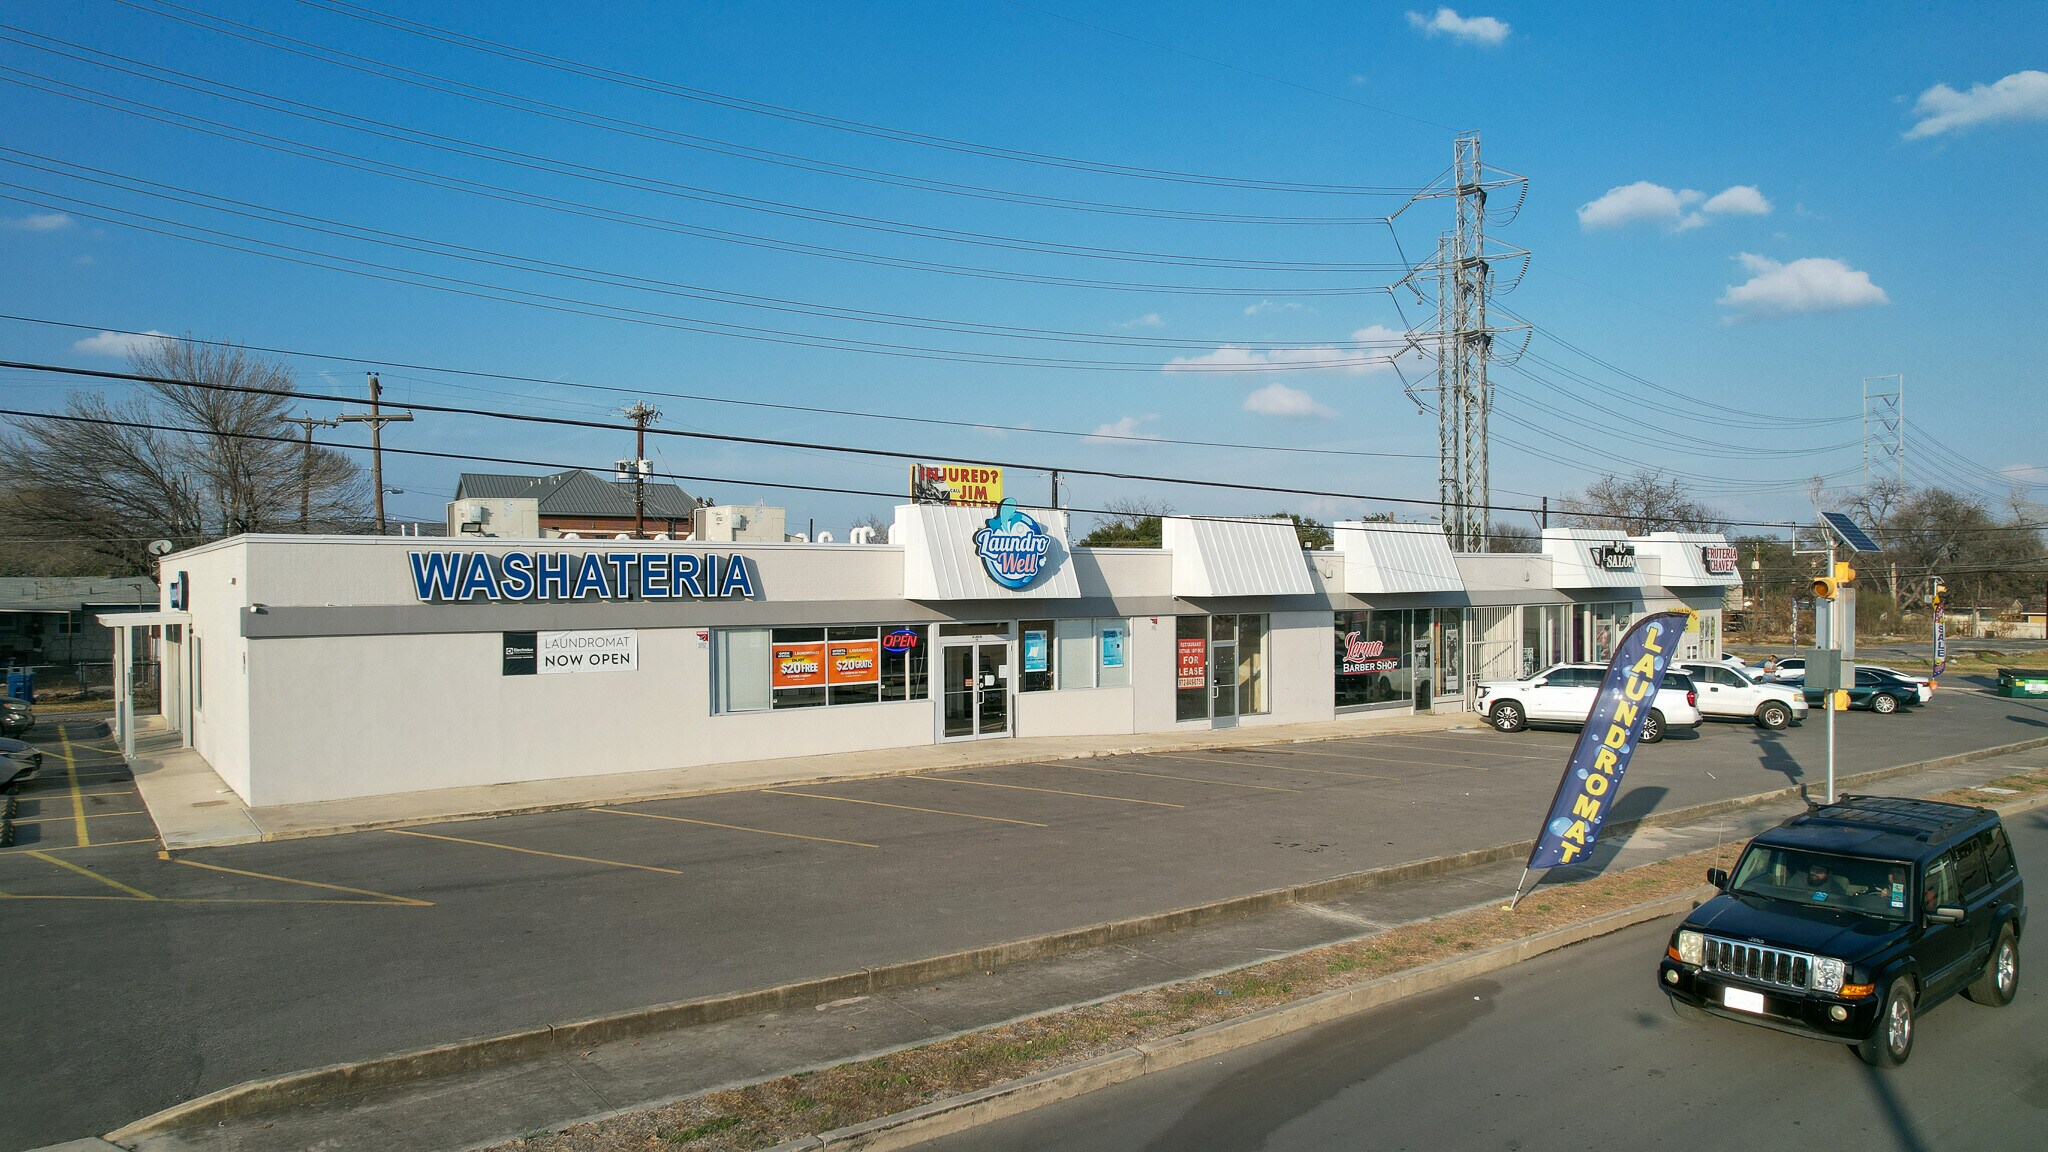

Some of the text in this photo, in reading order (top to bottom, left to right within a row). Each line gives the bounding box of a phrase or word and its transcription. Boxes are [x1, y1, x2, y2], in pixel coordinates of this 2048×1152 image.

[920, 466, 999, 484] INJURED?
[959, 485, 988, 500] JIM
[977, 529, 1049, 559] Laundro
[1707, 547, 1738, 559] FRUTERIA
[997, 552, 1037, 573] Well
[1606, 555, 1635, 568] SALON
[1710, 559, 1734, 572] CHAVEZ
[408, 551, 755, 600] WASHATERIA
[545, 637, 629, 649] LAUNDROMAT
[883, 634, 918, 648] OPEN
[1937, 625, 1945, 657] SALE
[545, 653, 630, 667] NOW OPEN
[836, 659, 873, 671] $20 GRATIS
[1183, 656, 1199, 664] FOR
[1343, 659, 1398, 673] BARBER SHOP
[781, 662, 819, 674] $20 FREE
[1178, 666, 1204, 676] LEASE
[1559, 626, 1662, 864] LAUNDROMAT
